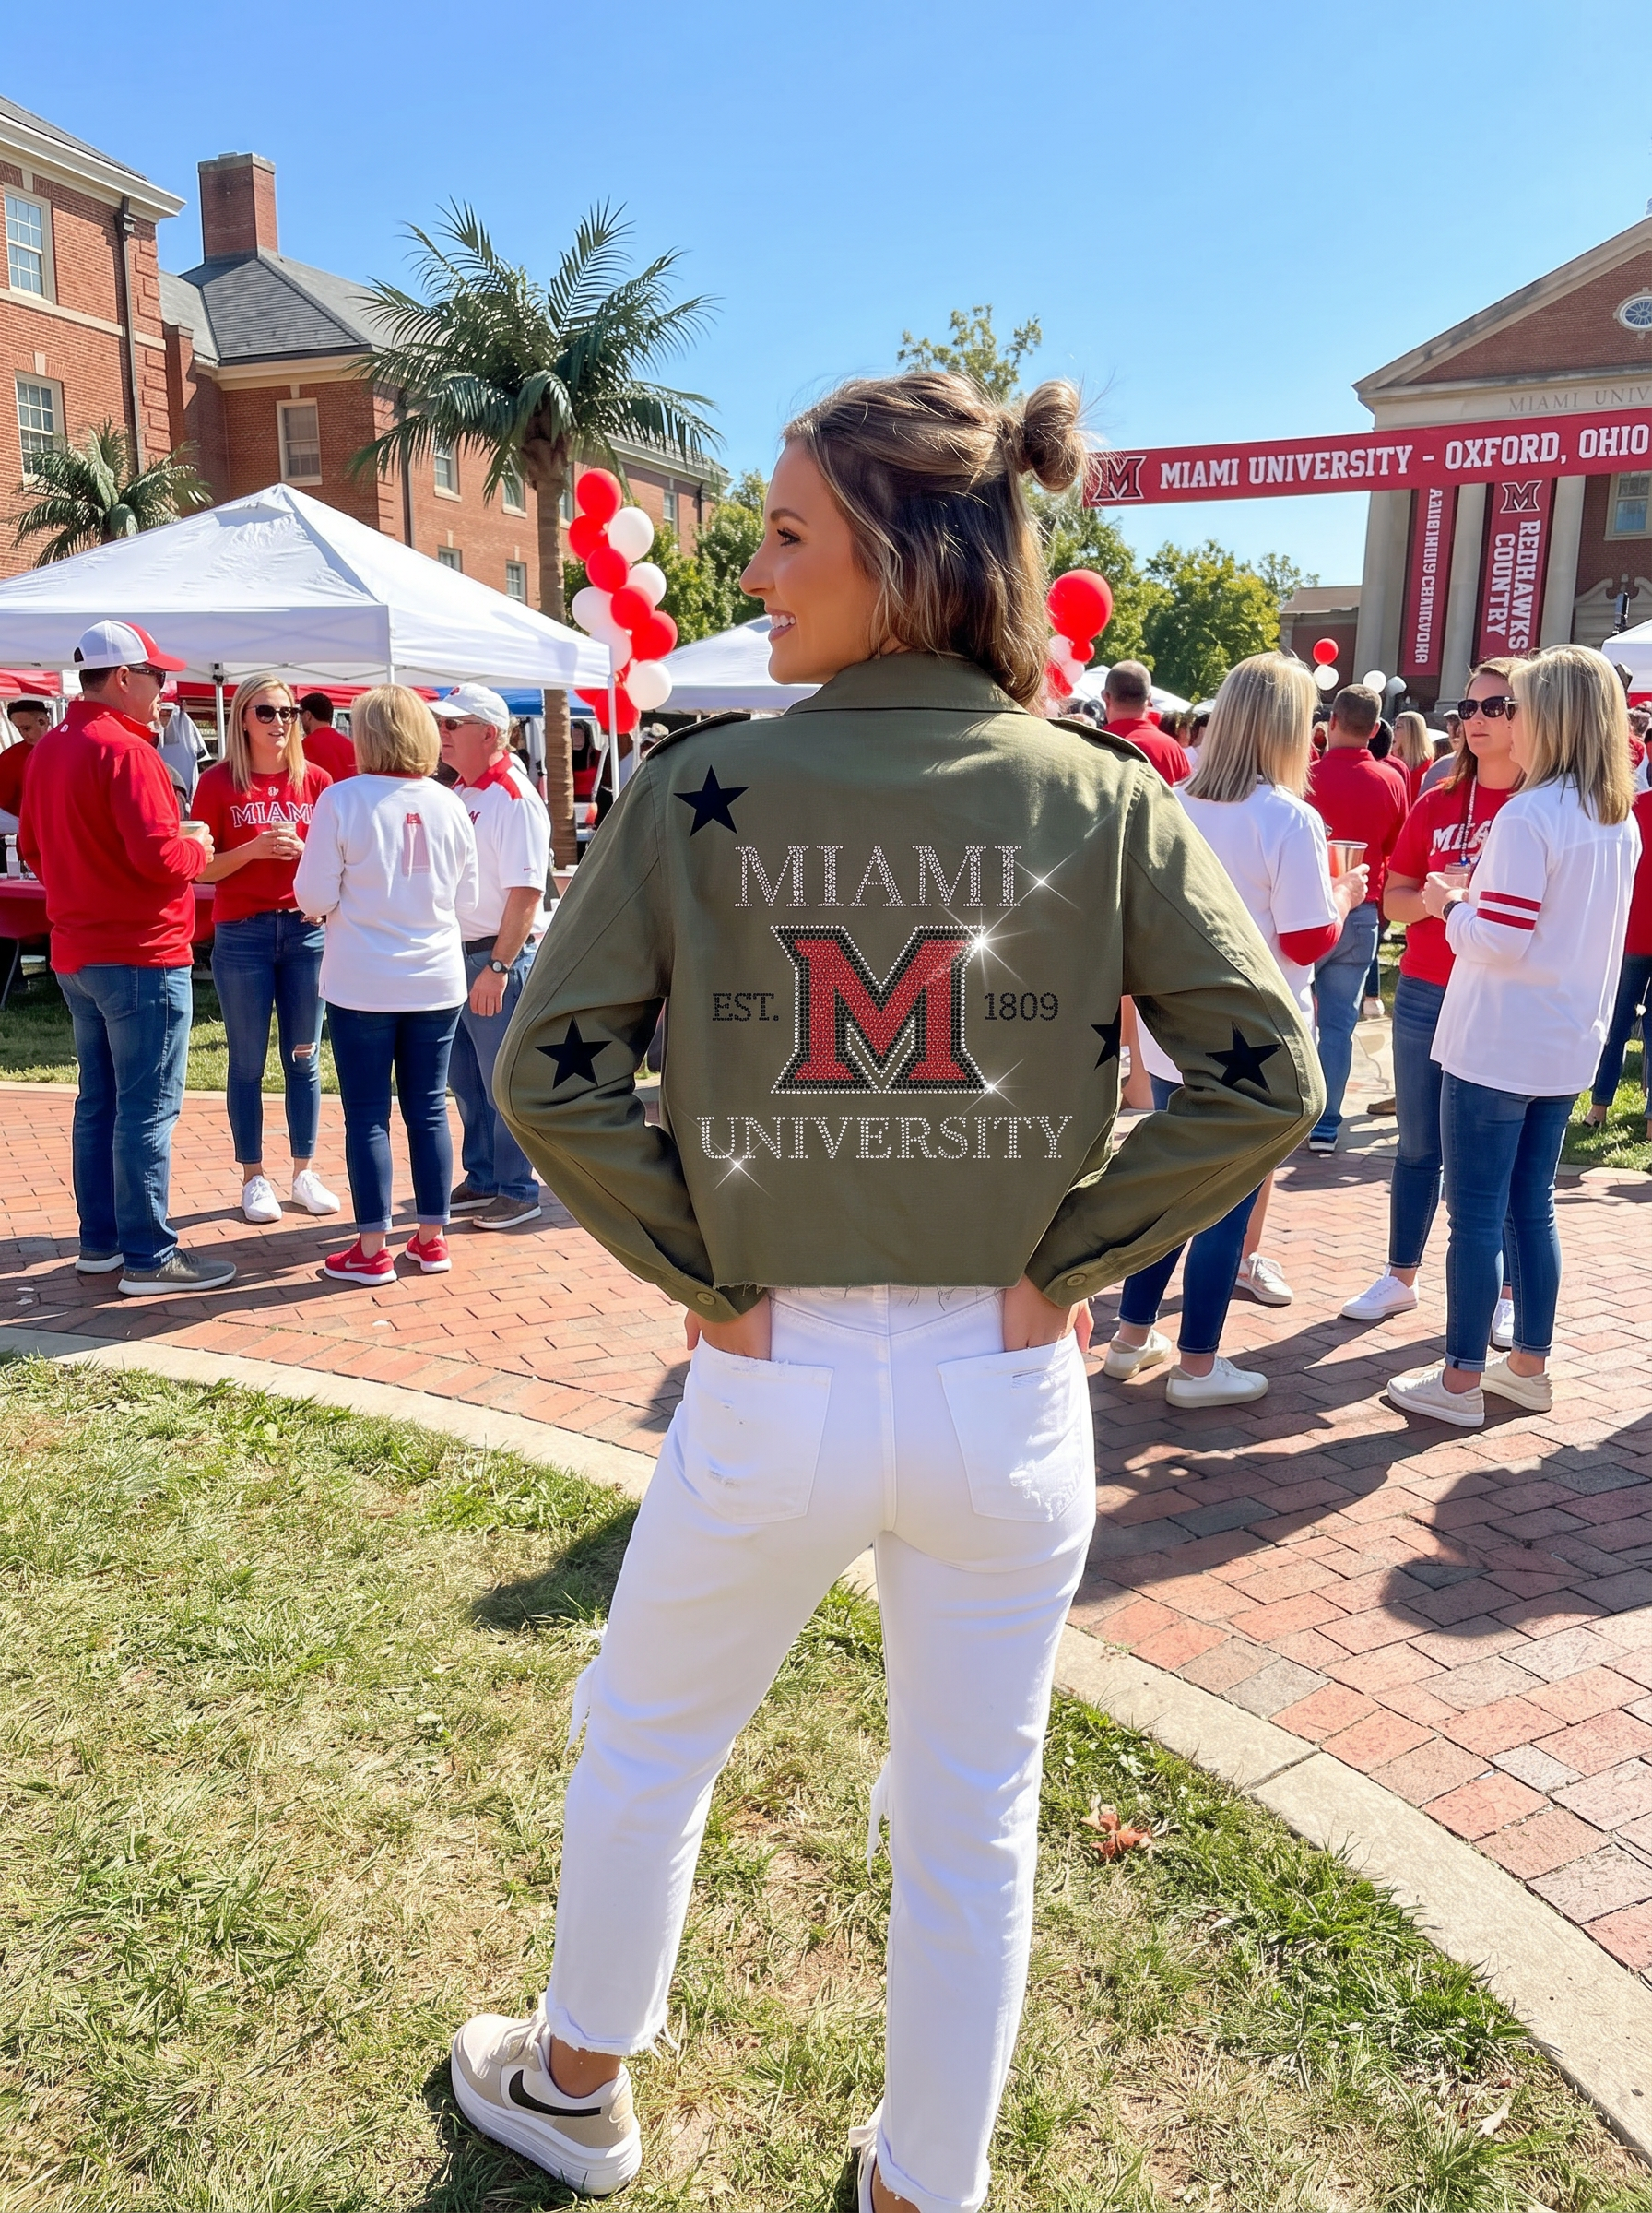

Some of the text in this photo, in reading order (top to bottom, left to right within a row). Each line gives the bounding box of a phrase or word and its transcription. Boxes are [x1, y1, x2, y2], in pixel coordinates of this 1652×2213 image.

[1509, 392, 1579, 413] MIAMI
[1160, 458, 1240, 490] MIAMI
[1248, 444, 1413, 485] UNIVERSITY
[1445, 432, 1567, 470] OXFORD,
[1578, 424, 1650, 459] OHIO
[1486, 533, 1516, 636] COUNTRY
[734, 845, 1022, 907] MIAMI
[712, 992, 1059, 1023] EST. 1809
[696, 1115, 1073, 1160] UNIVERSITY
